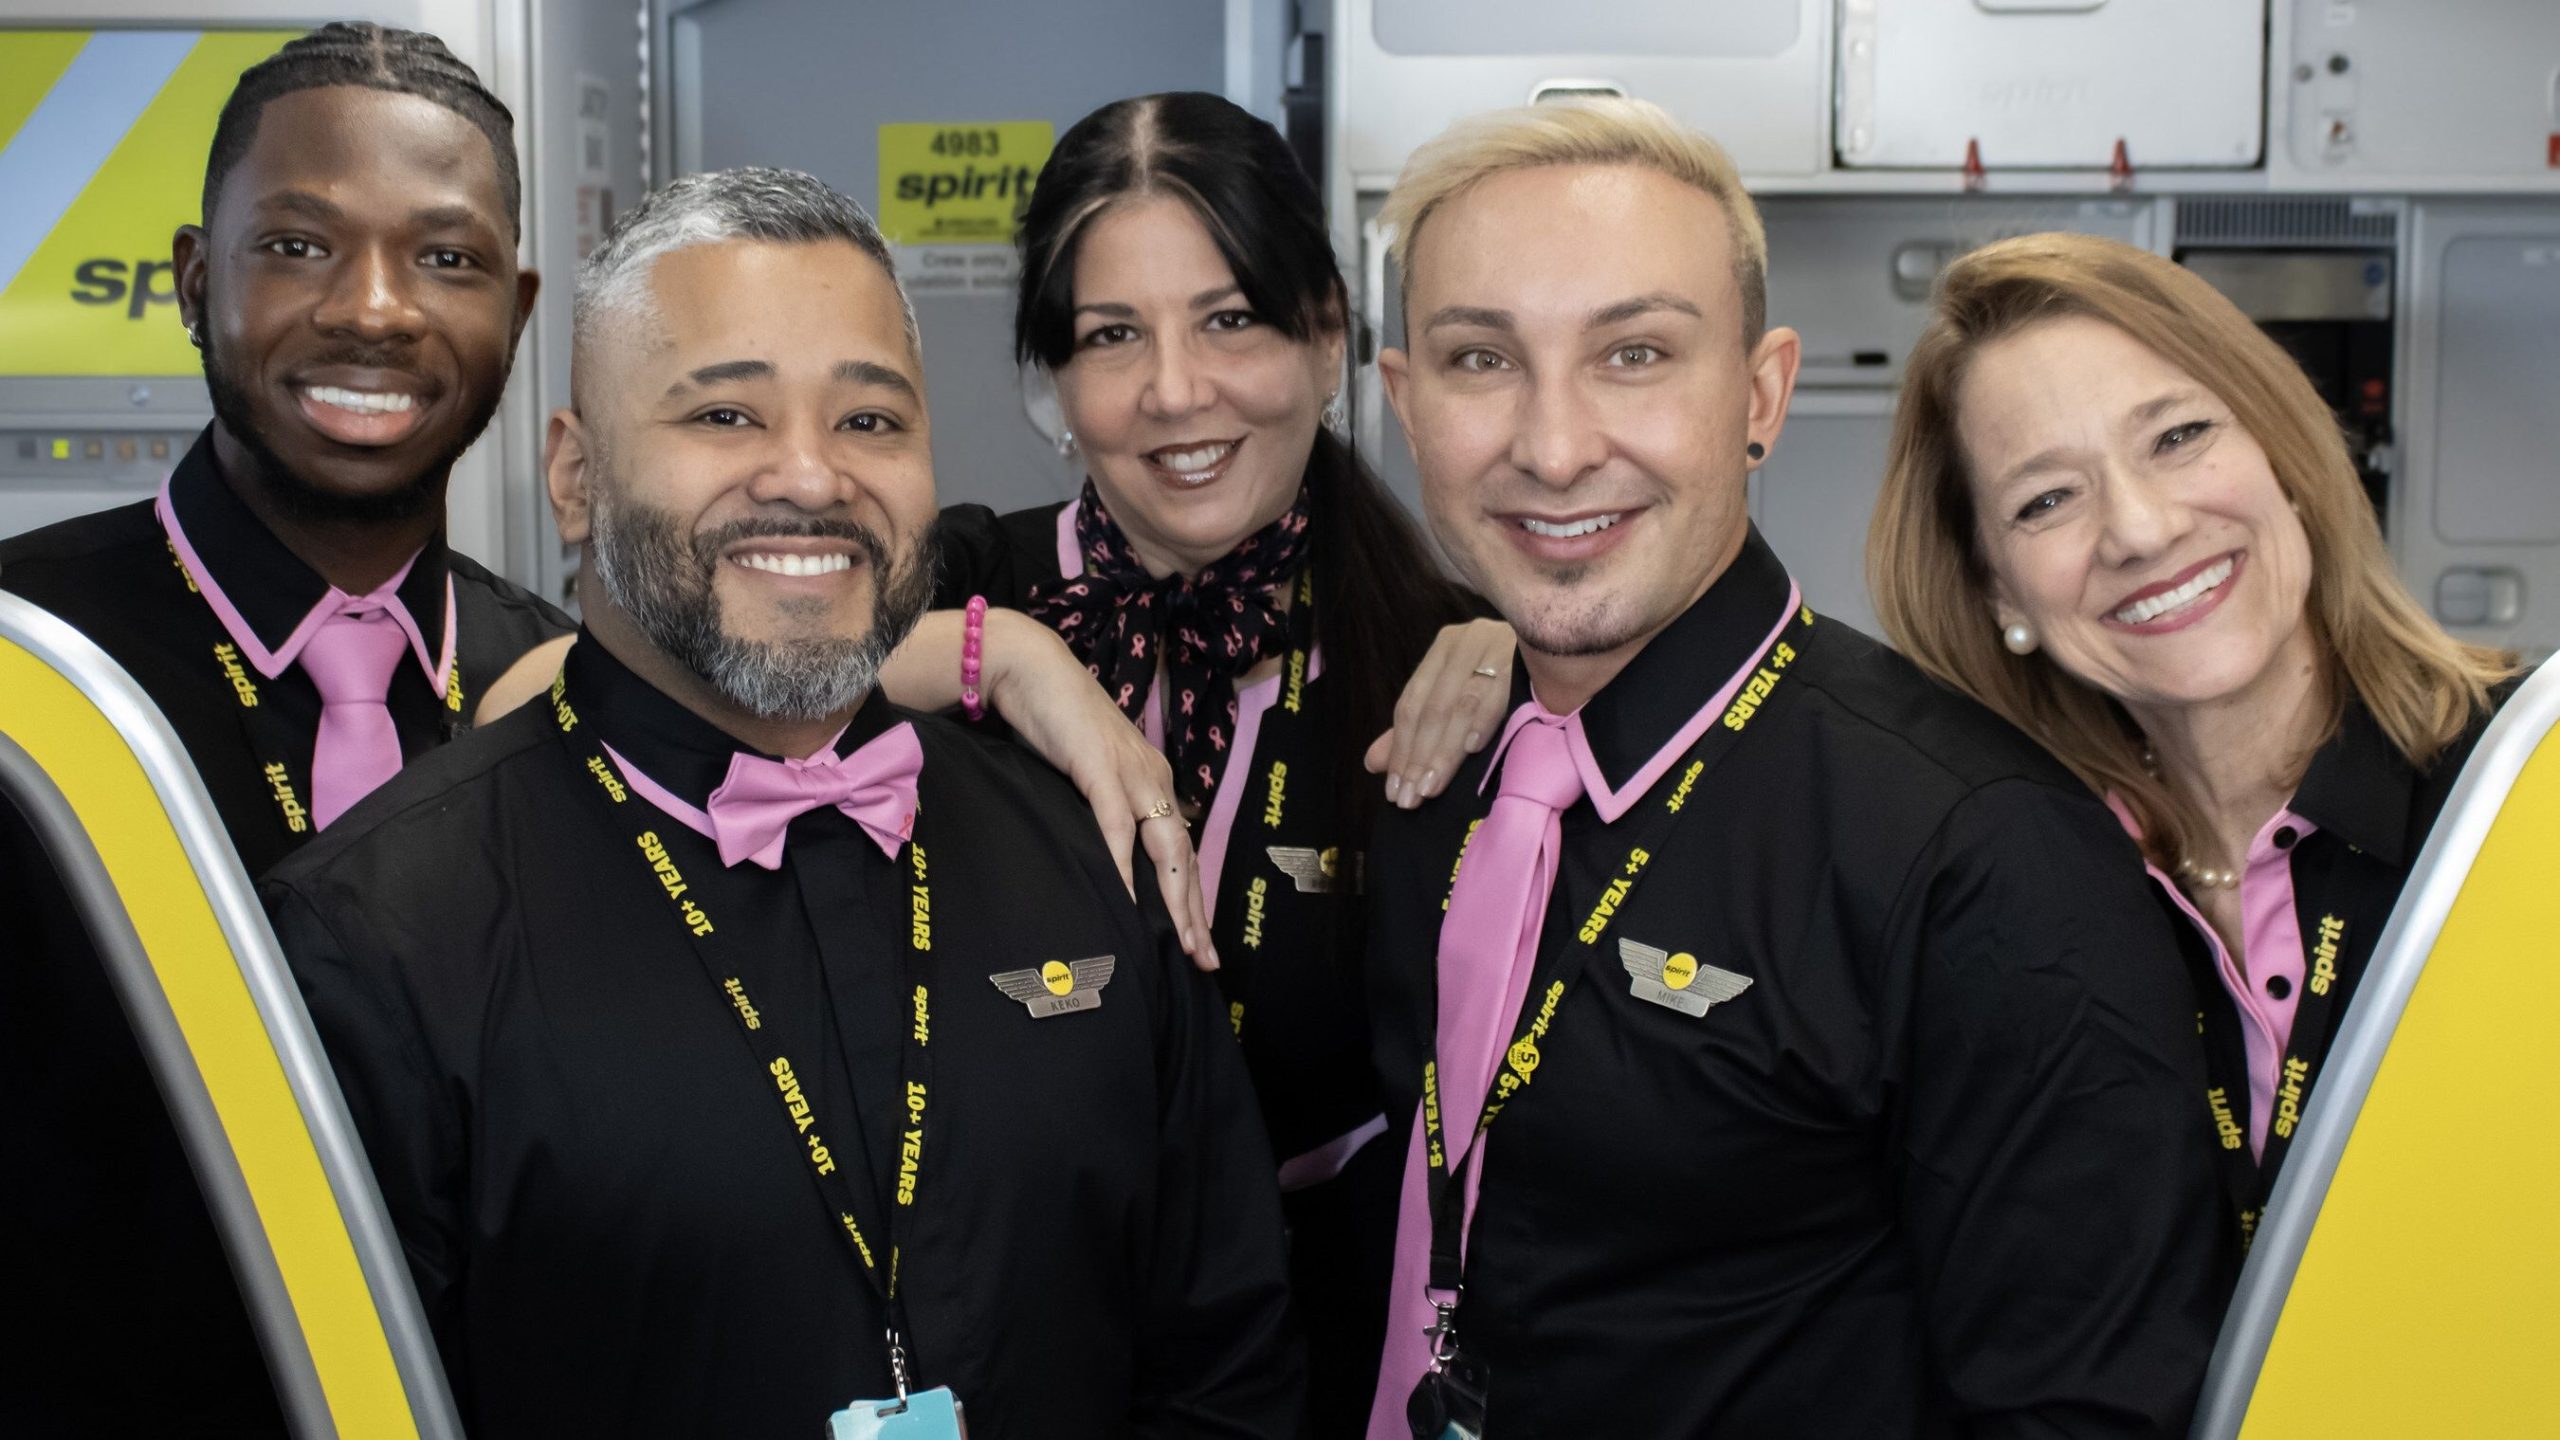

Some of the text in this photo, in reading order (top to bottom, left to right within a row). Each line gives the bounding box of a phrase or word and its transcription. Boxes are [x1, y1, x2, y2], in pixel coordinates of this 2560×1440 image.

[931, 129, 1000, 157] 4983
[896, 166, 1035, 209] spirit
[70, 257, 177, 321] sp
[213, 643, 260, 708] spirit
[1284, 648, 1305, 713] spirit
[1723, 641, 1797, 731] 5+ YEARS
[557, 701, 578, 732] 10+
[264, 762, 307, 833] spirit
[586, 755, 628, 804] spirit
[1263, 760, 1288, 827] spirit
[1666, 759, 1705, 813] spirit
[636, 830, 715, 937] 10+ YEARS
[911, 842, 932, 952] 10+ YEARS
[1245, 878, 1267, 946] spirit
[1577, 846, 1650, 945] 5+ YEARS
[1046, 974, 1071, 985] spirit
[1666, 966, 1691, 977] spirit
[2310, 915, 2345, 996] spirit
[724, 978, 761, 1030] spirit
[911, 984, 929, 1046] spirit
[1049, 997, 1082, 1013] KEKO
[1532, 980, 1565, 1039] spirit
[1497, 1072, 1520, 1099] 5+
[1521, 1051, 1536, 1064] 5
[767, 1056, 837, 1177] 10+ YEARS
[1424, 1061, 1443, 1167] 5+ YEARS
[2274, 1056, 2309, 1139] spirit
[896, 1080, 927, 1206] 10+ YEARS
